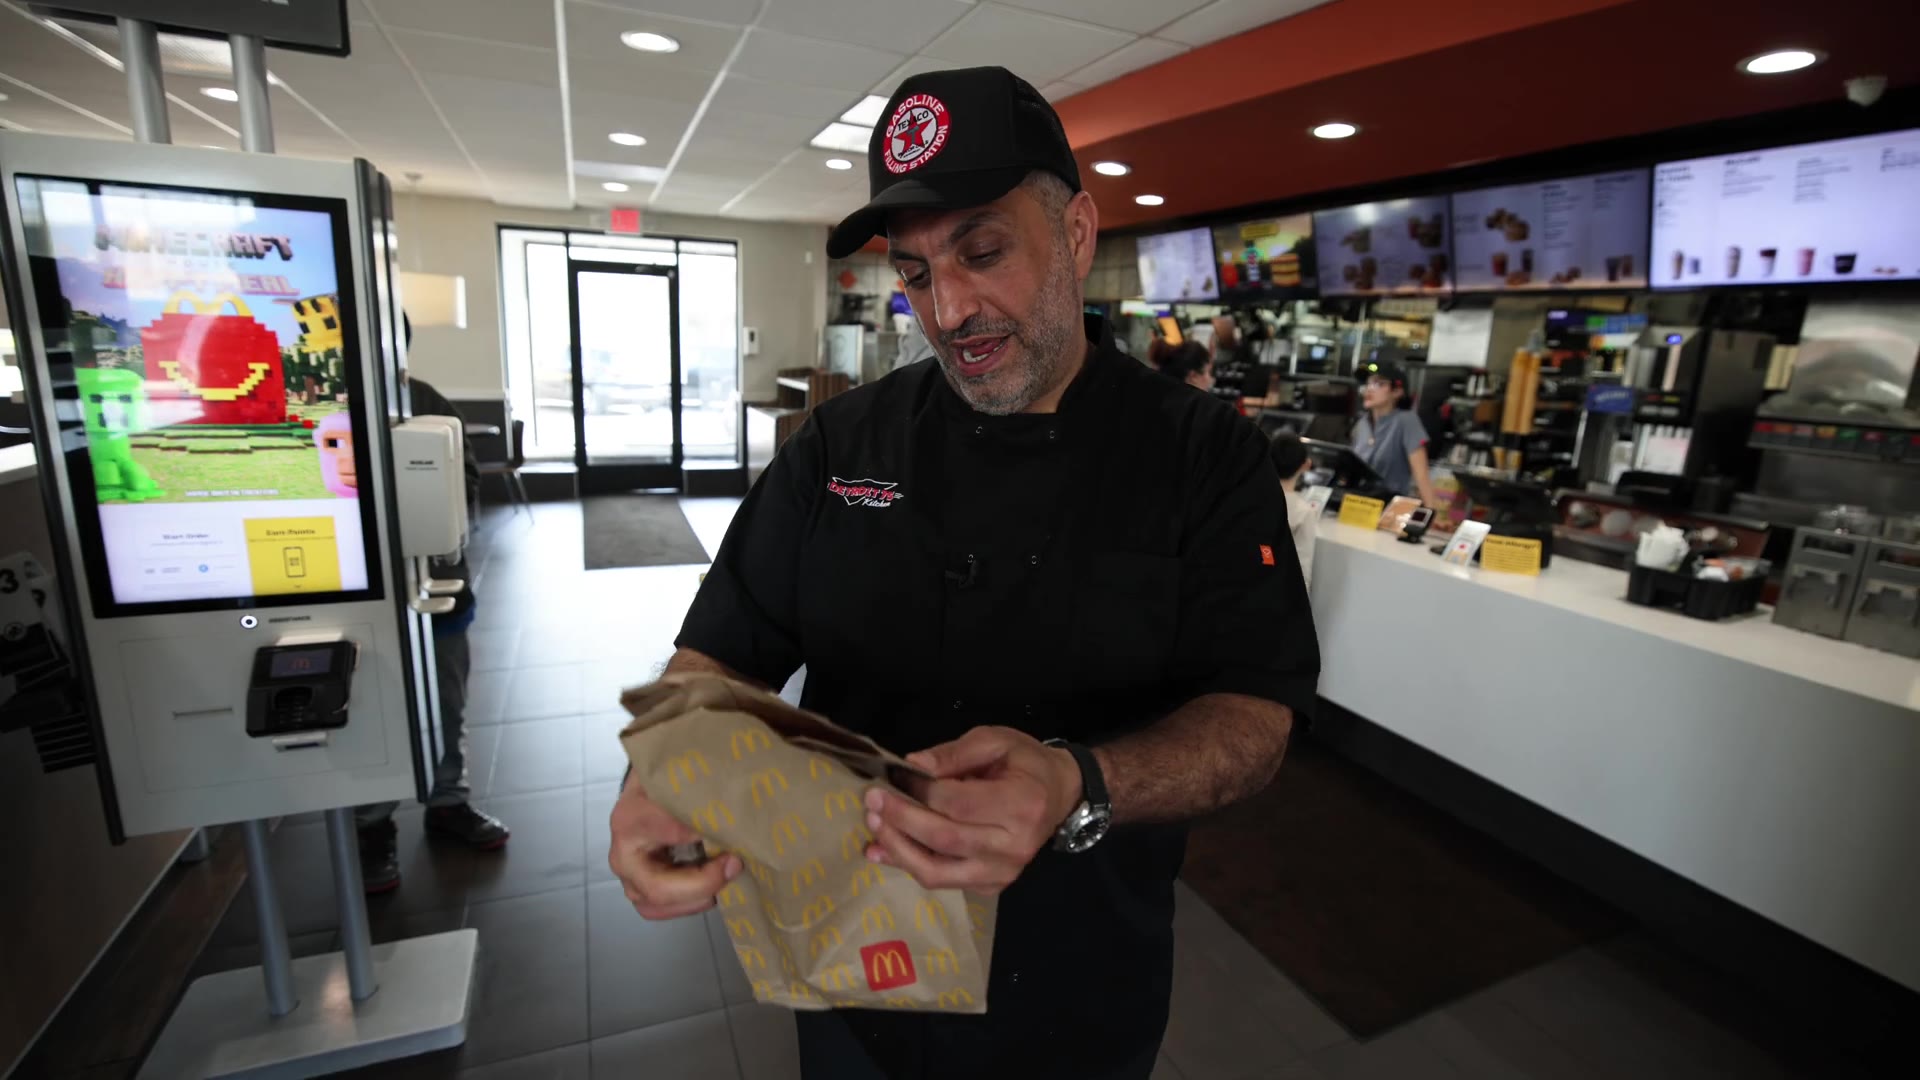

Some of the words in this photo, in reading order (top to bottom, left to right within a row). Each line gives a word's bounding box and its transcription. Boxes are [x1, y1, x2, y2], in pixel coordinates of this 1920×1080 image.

[886, 94, 944, 138] GASOLINE
[897, 110, 929, 131] TEXACO
[884, 149, 907, 174] FILLING
[909, 124, 949, 170] STATION
[828, 481, 880, 499] DETROIT
[862, 498, 891, 508] Kitchen
